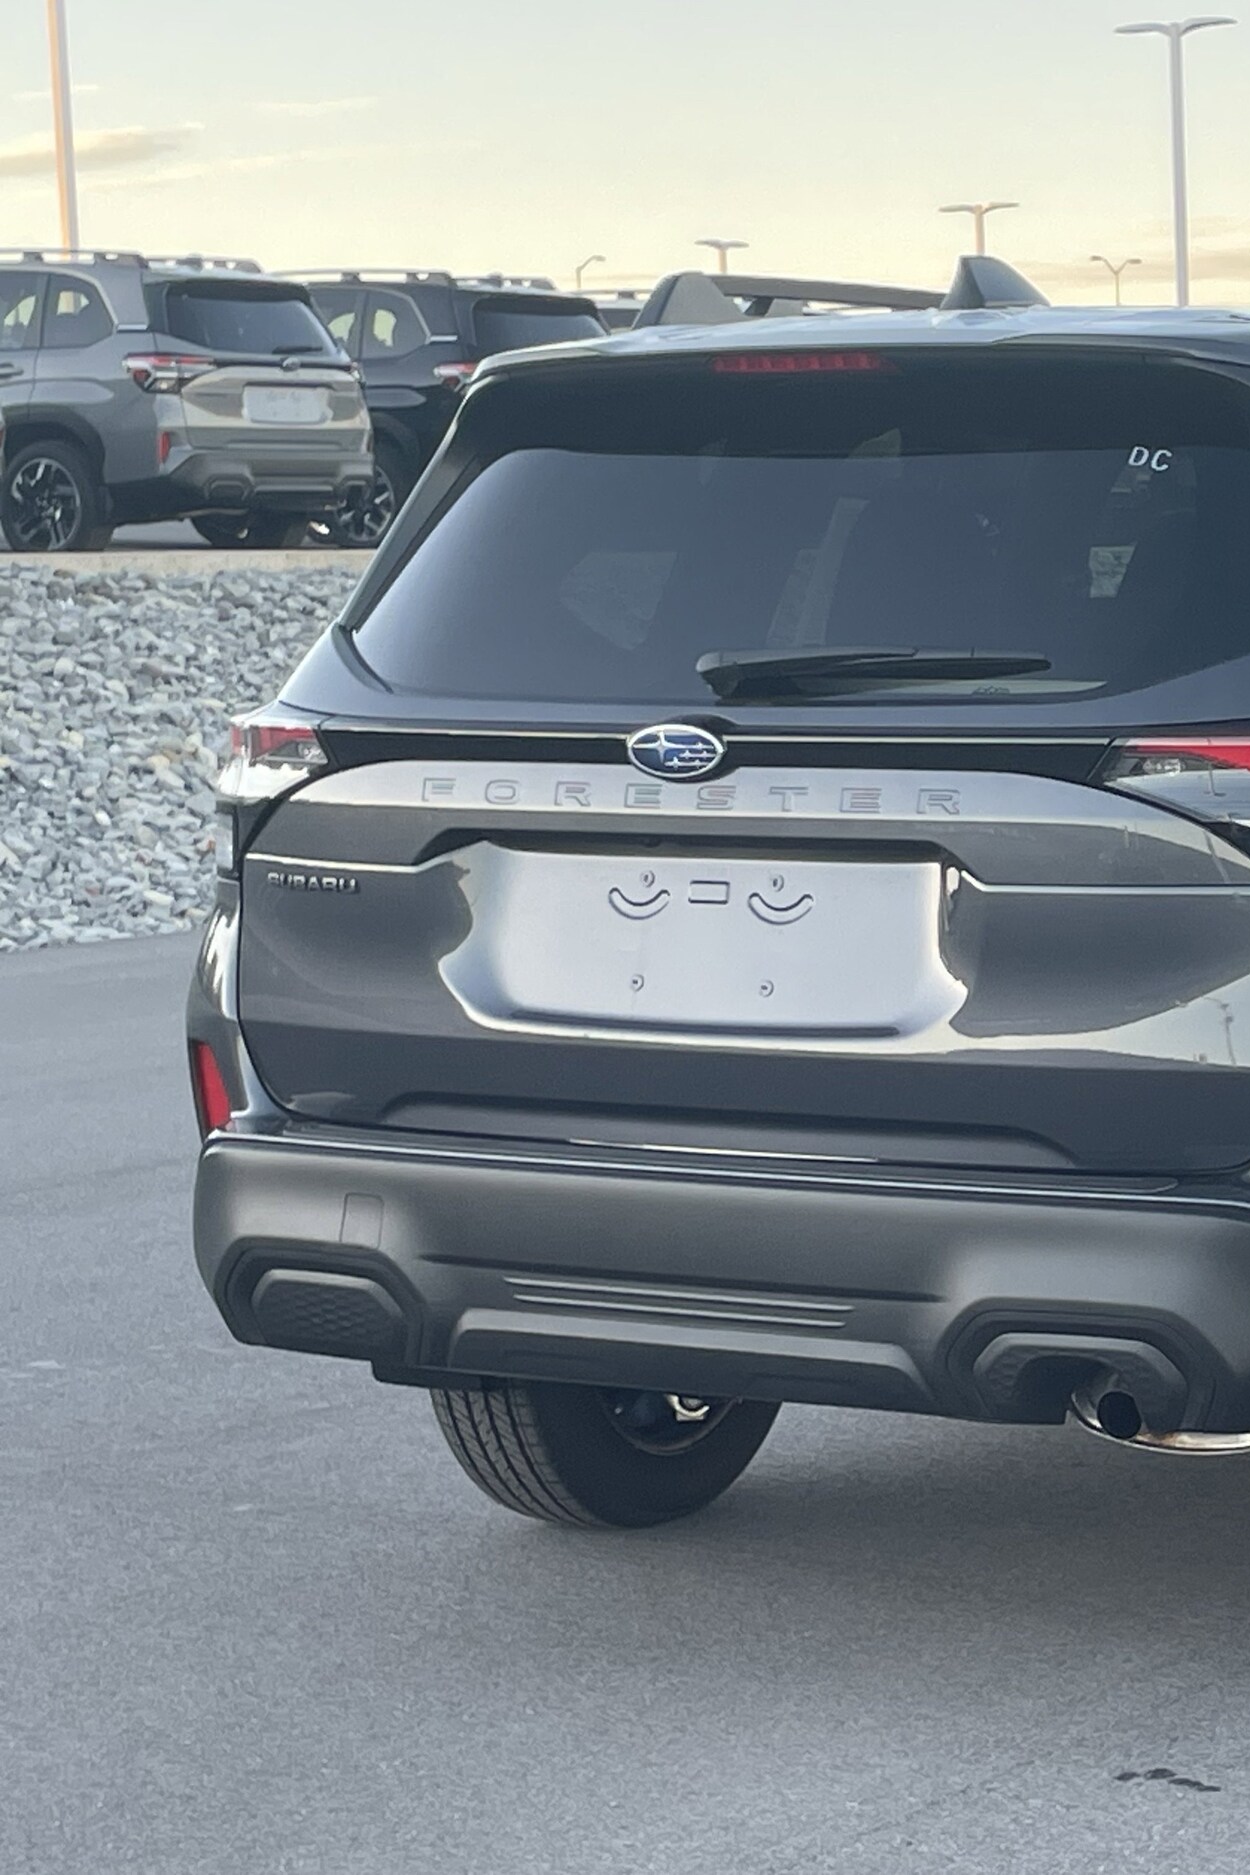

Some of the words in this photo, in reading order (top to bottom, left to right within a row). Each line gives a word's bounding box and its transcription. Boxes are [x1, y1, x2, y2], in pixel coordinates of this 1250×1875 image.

[1127, 445, 1173, 471] DC
[420, 776, 962, 815] FORESTER
[267, 871, 358, 893] SUBARU
